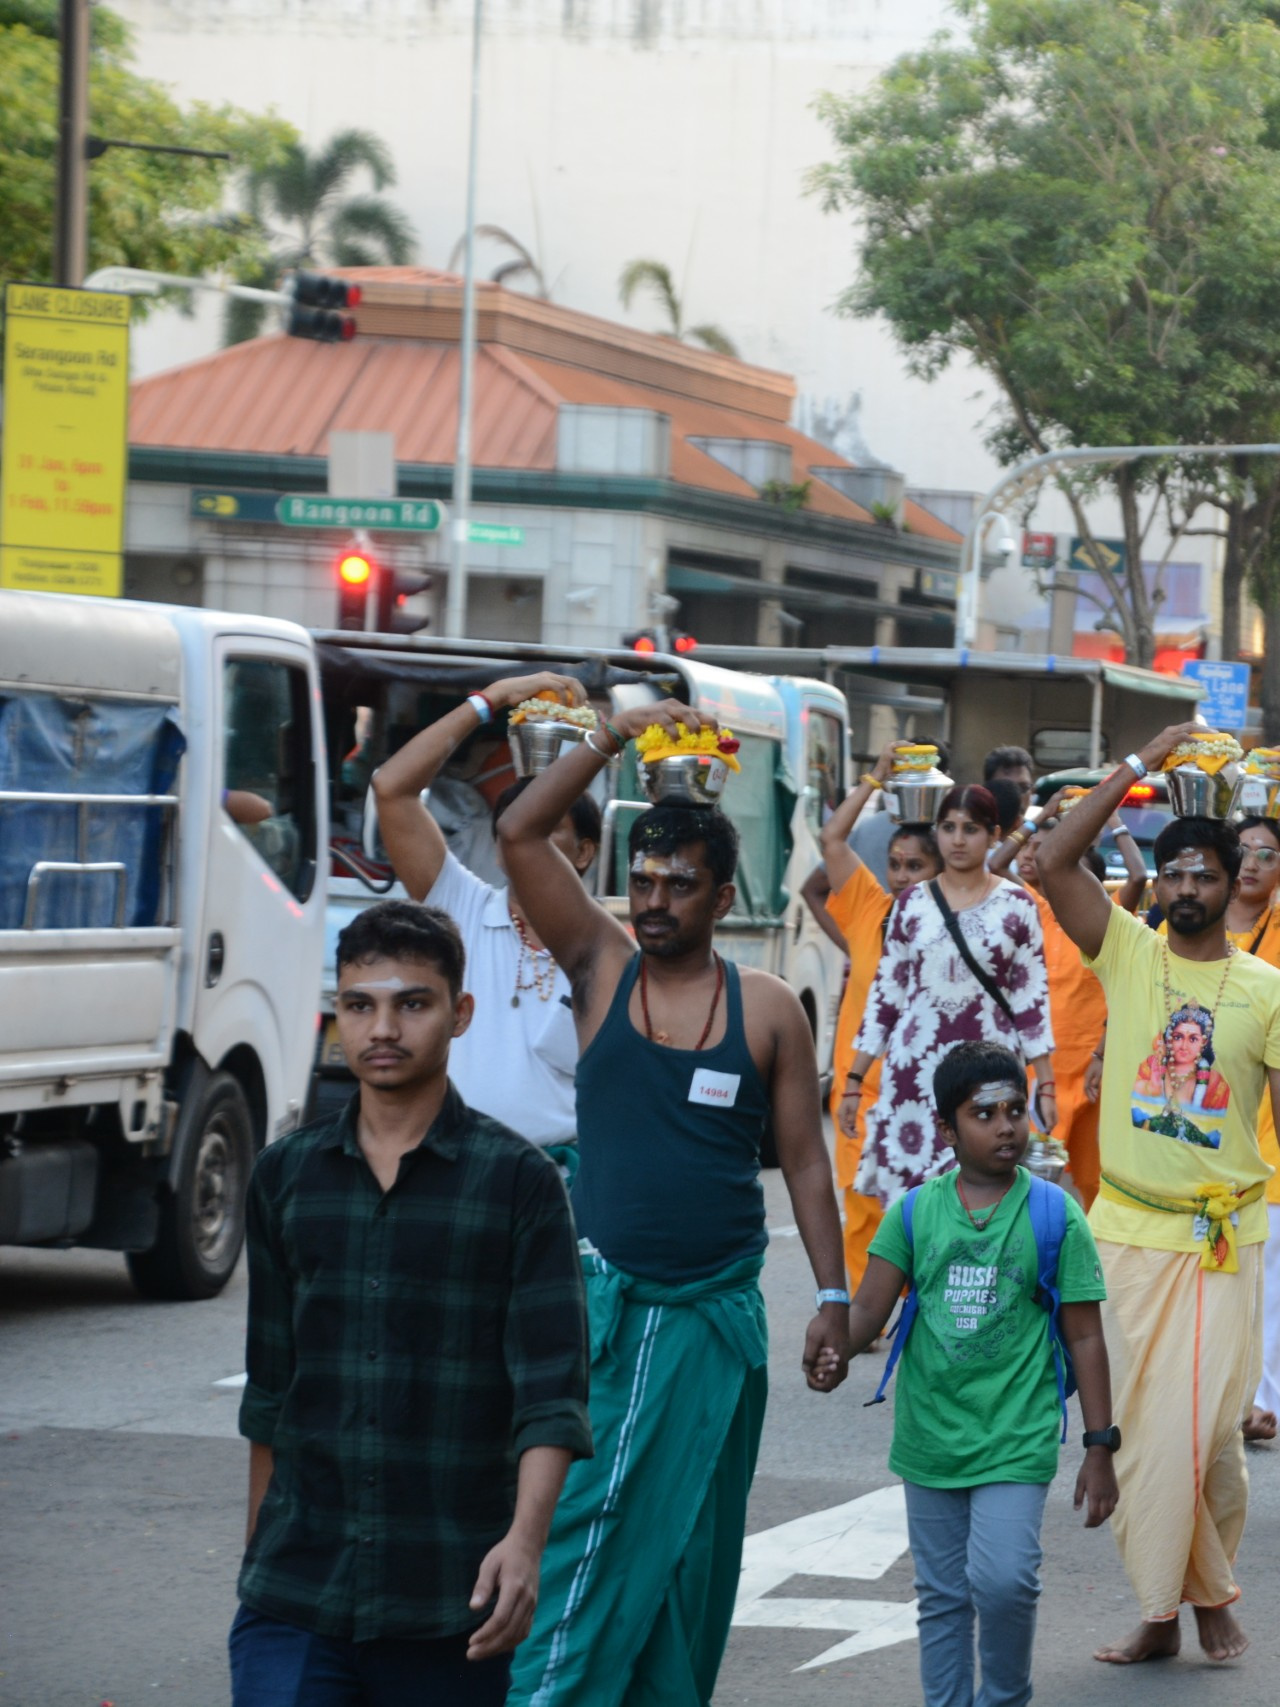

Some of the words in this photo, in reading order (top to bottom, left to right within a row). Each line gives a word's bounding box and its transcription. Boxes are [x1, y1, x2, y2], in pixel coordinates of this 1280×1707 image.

[10, 287, 49, 312] LANE
[55, 293, 124, 319] CLOSURE
[291, 499, 392, 524] Rangoon
[402, 504, 430, 523] Rd
[1213, 678, 1244, 693] Lane
[700, 1086, 728, 1099] 14984
[948, 1265, 998, 1287] HUSH
[944, 1289, 997, 1303] PUPPIES
[956, 1317, 978, 1329] USA
